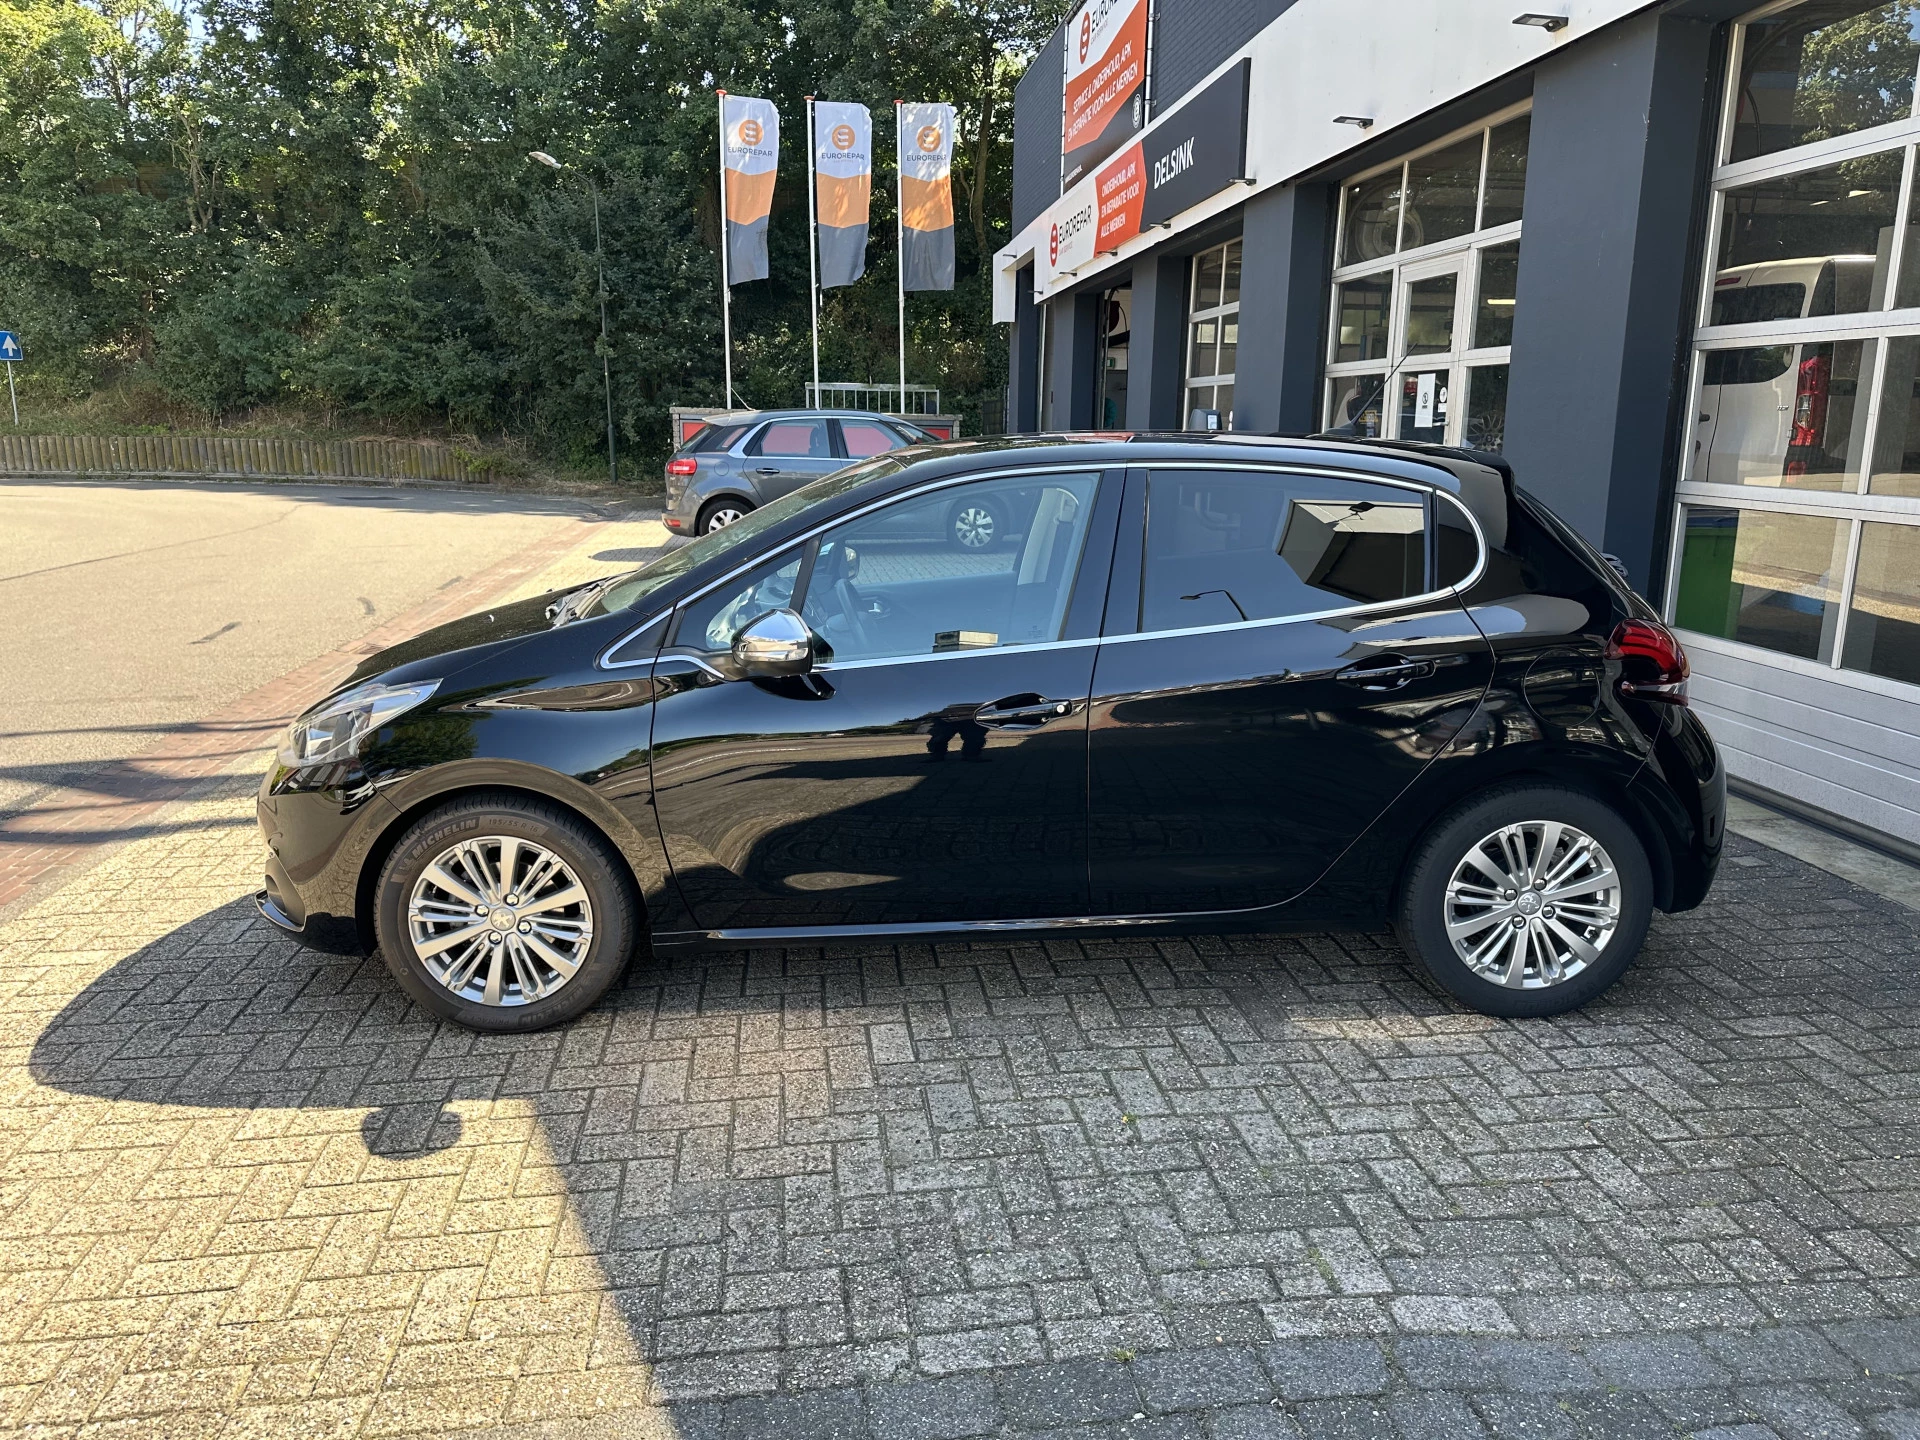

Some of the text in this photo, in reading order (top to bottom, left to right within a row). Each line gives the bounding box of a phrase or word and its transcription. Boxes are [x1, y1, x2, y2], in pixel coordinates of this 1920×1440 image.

[1073, 86, 1089, 116] SERVICE
[1092, 53, 1120, 94] ONDERHOUD,
[1120, 40, 1132, 65] APK
[1072, 110, 1092, 137] REPARATIE
[1091, 92, 1105, 117] VOOR
[1104, 80, 1116, 103] ALLE
[1116, 60, 1138, 94] MERKEN
[728, 146, 773, 157] EUROREPAR
[821, 152, 865, 161] EUROREPAR
[1153, 136, 1195, 190] DELSINK
[1101, 169, 1127, 198] ONDERHOUD,
[1126, 161, 1136, 180] APK
[1101, 181, 1140, 218] EN REPARATIE VOOR
[1058, 204, 1092, 244] EUROREPAR
[1100, 211, 1126, 238] ALLE MERKEN
[412, 819, 476, 859] MICHELIN
[489, 818, 518, 827] 195/55
